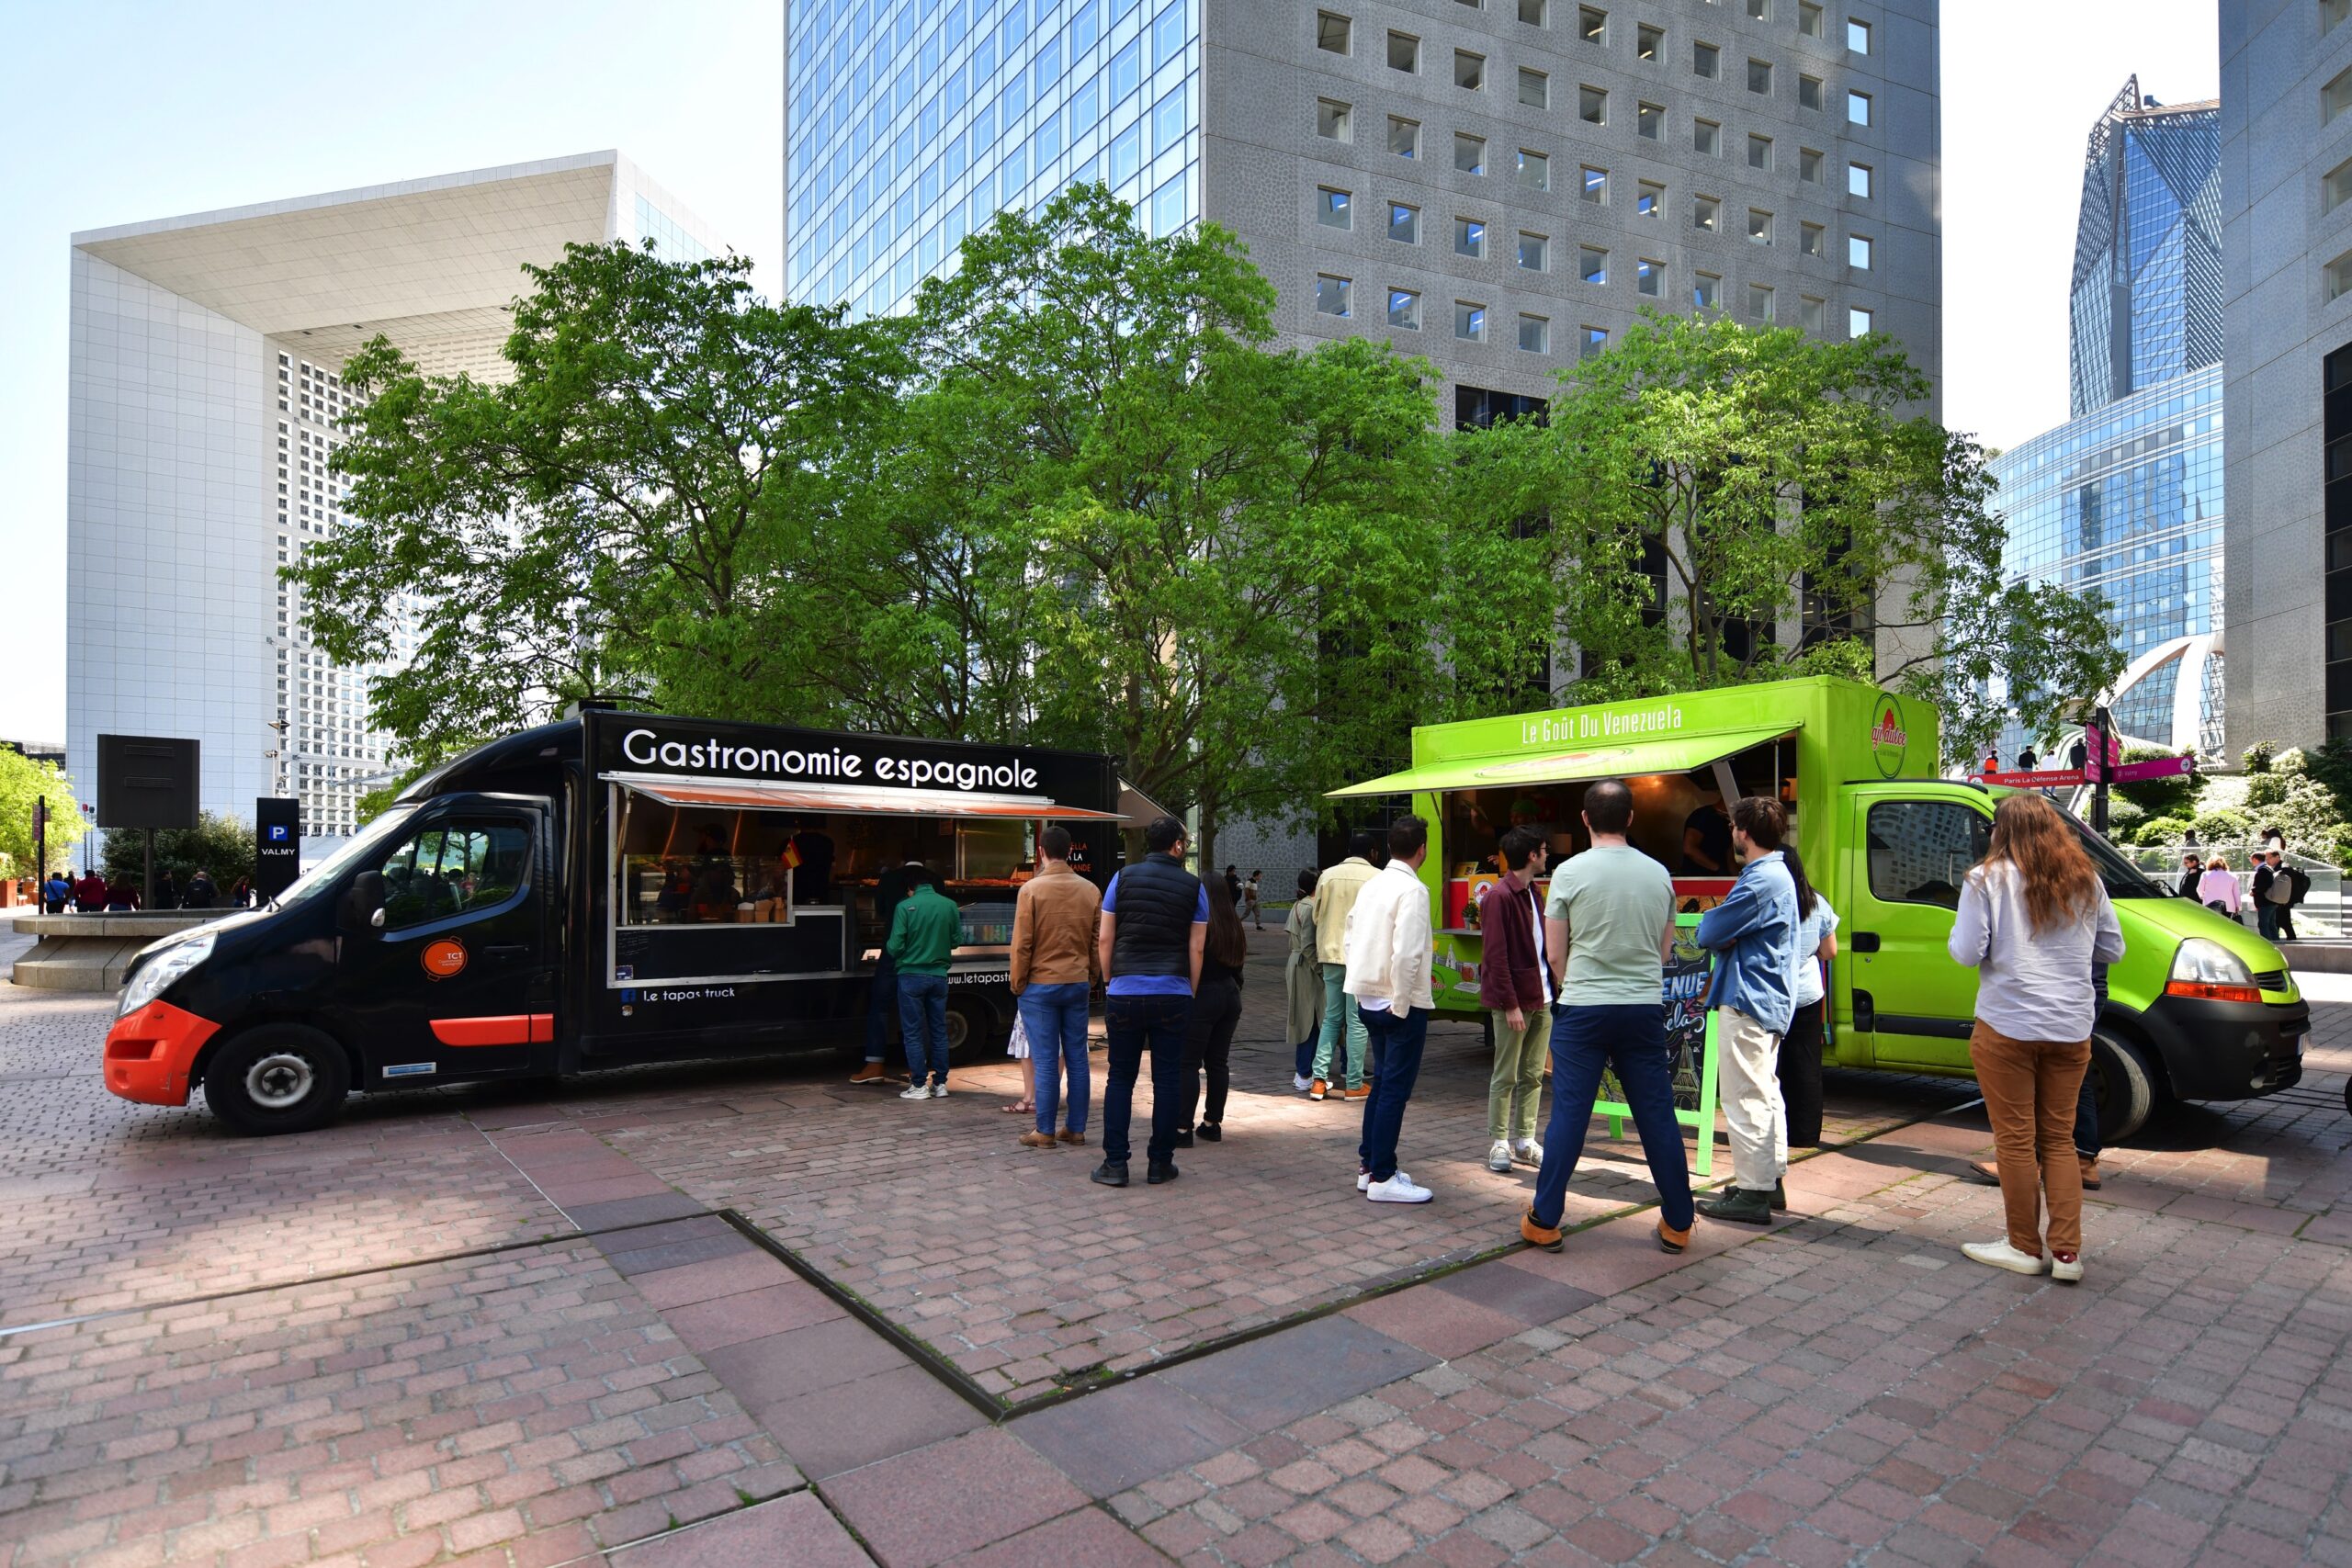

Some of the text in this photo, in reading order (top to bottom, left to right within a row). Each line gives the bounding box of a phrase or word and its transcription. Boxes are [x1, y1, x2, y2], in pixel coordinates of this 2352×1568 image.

[1522, 705, 1681, 744] Le Goût Du Venezuela
[623, 728, 1038, 790] Gastronomie espagnole
[273, 827, 285, 839] P
[1073, 852, 1083, 862] LA
[447, 952, 464, 960] TCT
[643, 990, 659, 1001] Le
[705, 987, 735, 998] truck
